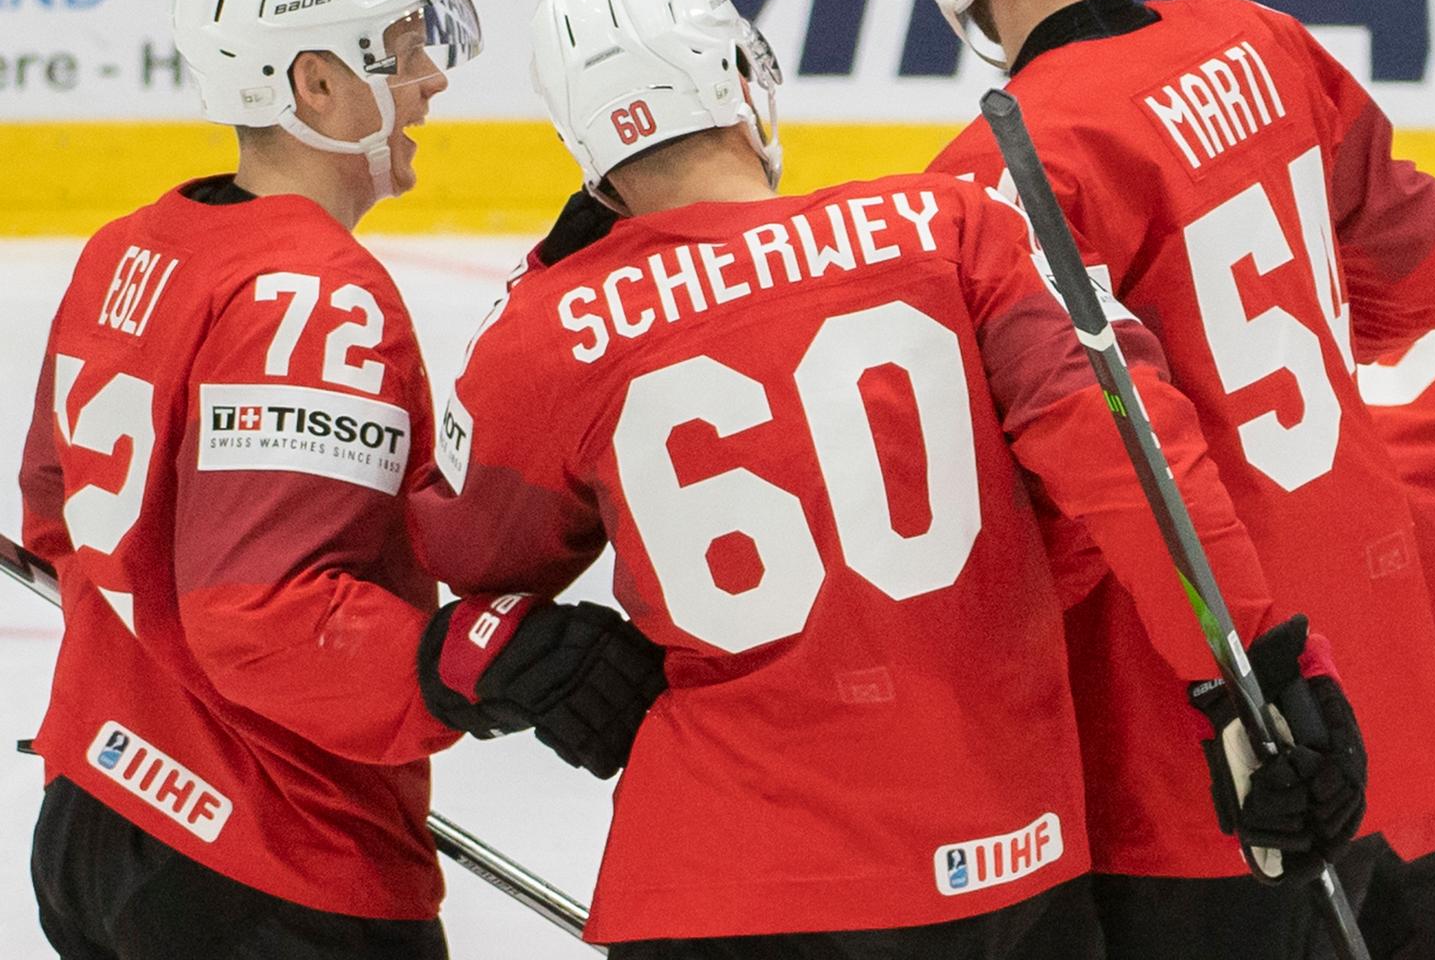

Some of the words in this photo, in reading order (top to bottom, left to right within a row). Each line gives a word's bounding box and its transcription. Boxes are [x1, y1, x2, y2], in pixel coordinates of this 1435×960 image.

[610, 99, 657, 146] 60
[1144, 41, 1287, 169] MARTI
[98, 245, 179, 338] EGLI
[557, 190, 940, 364] SCHERWEY
[255, 271, 385, 393] 72
[209, 437, 252, 449] SWISS
[259, 438, 326, 455] WATCHES
[333, 448, 372, 465] SINCE
[267, 406, 405, 455] TISSOT
[613, 300, 982, 654] 60
[122, 747, 222, 825] IIHF
[975, 820, 1050, 882] IIHF
